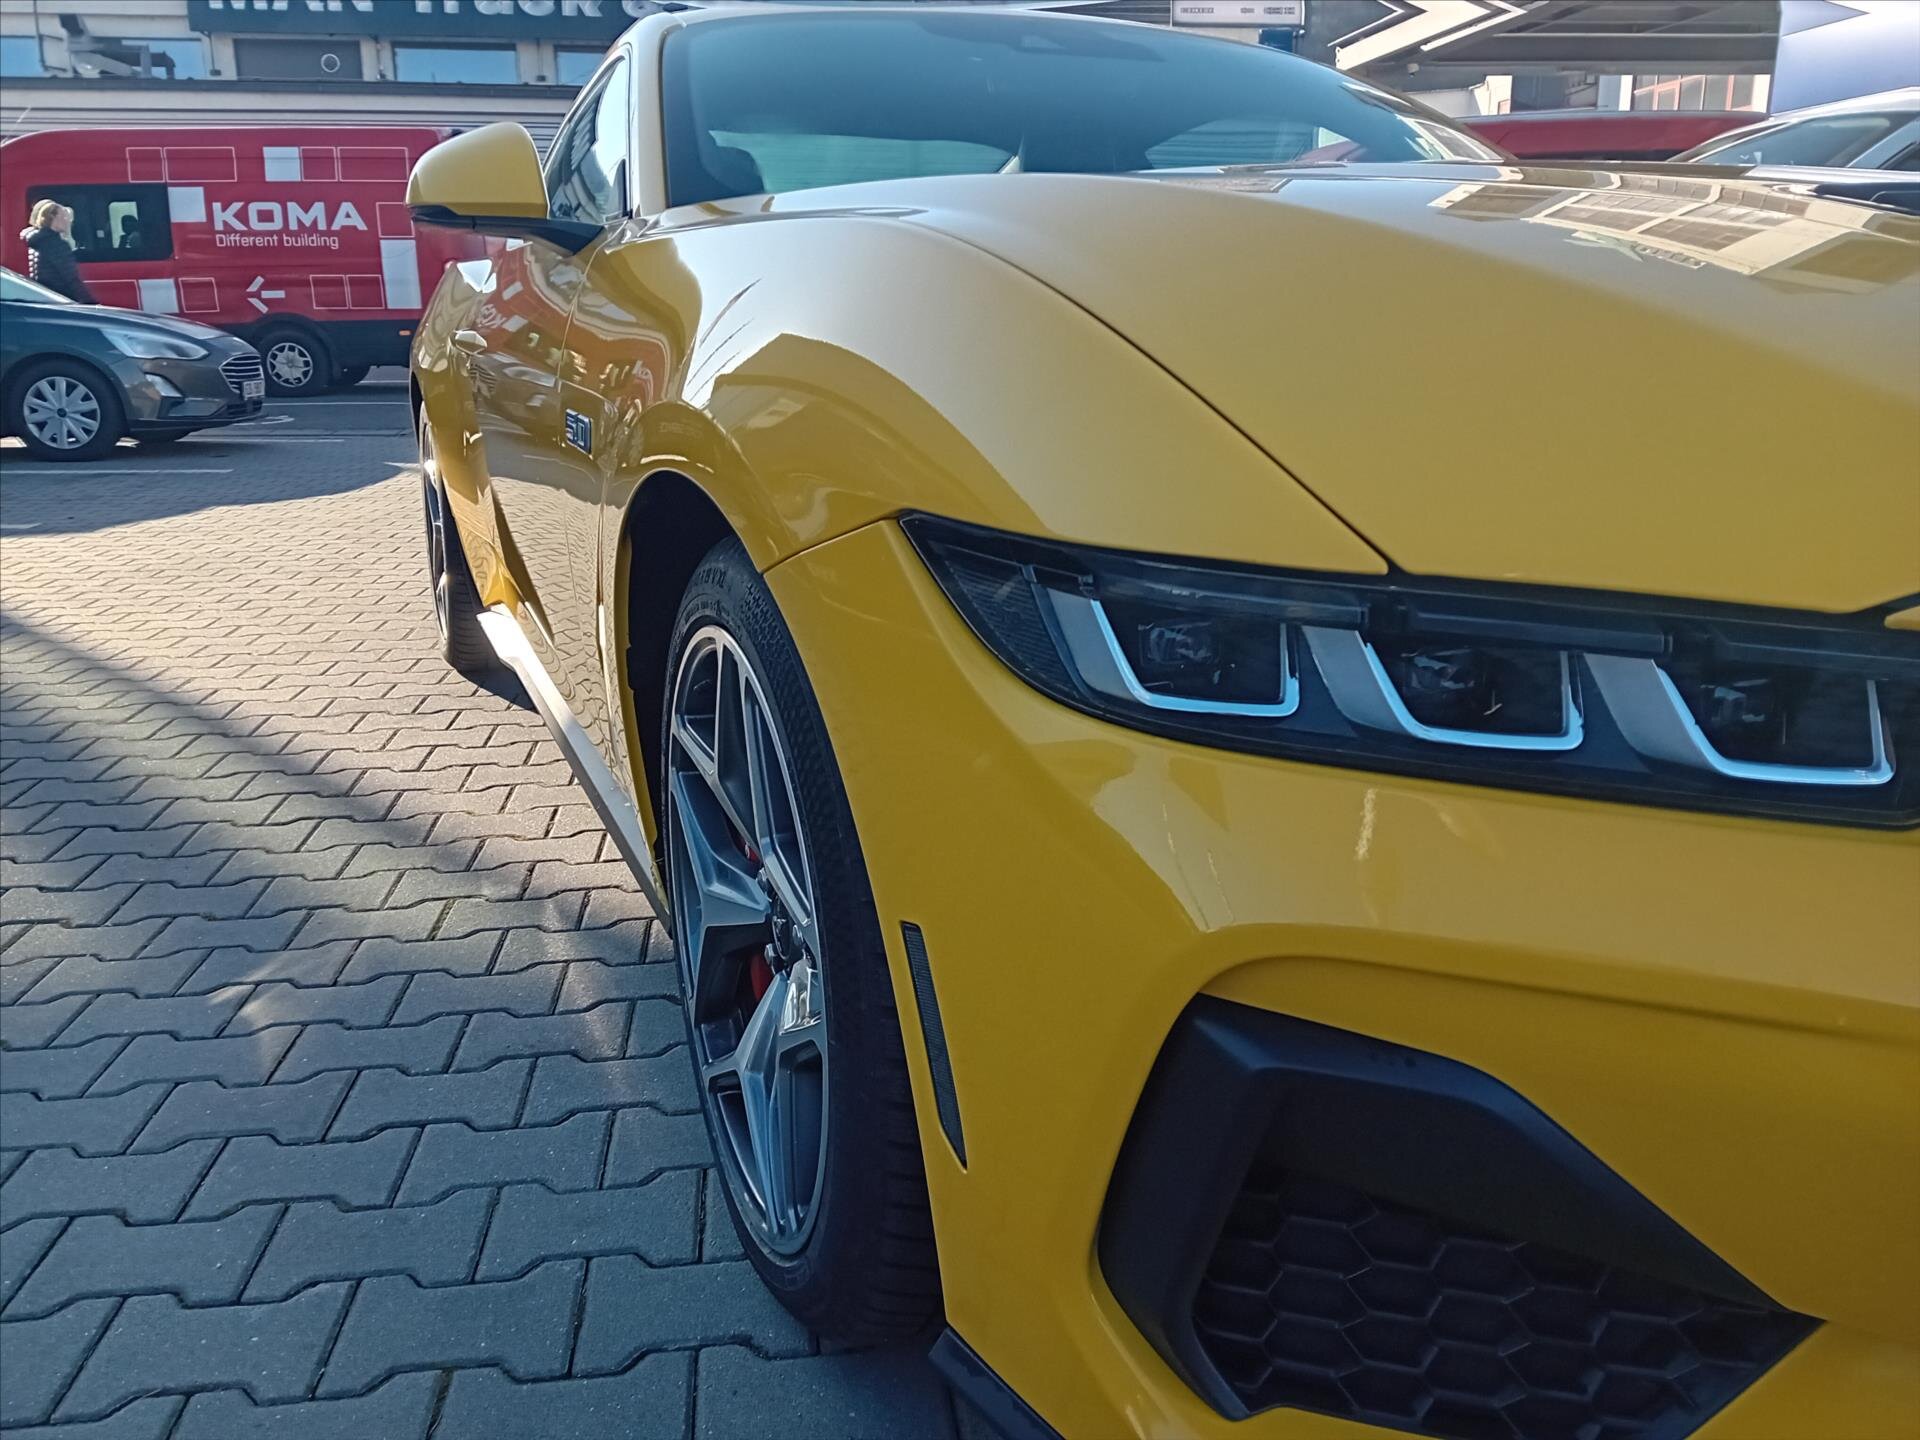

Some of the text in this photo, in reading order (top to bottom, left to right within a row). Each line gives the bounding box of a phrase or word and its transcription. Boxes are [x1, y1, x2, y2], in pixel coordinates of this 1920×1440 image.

[212, 201, 369, 231] KOMA
[215, 233, 339, 249] Different building
